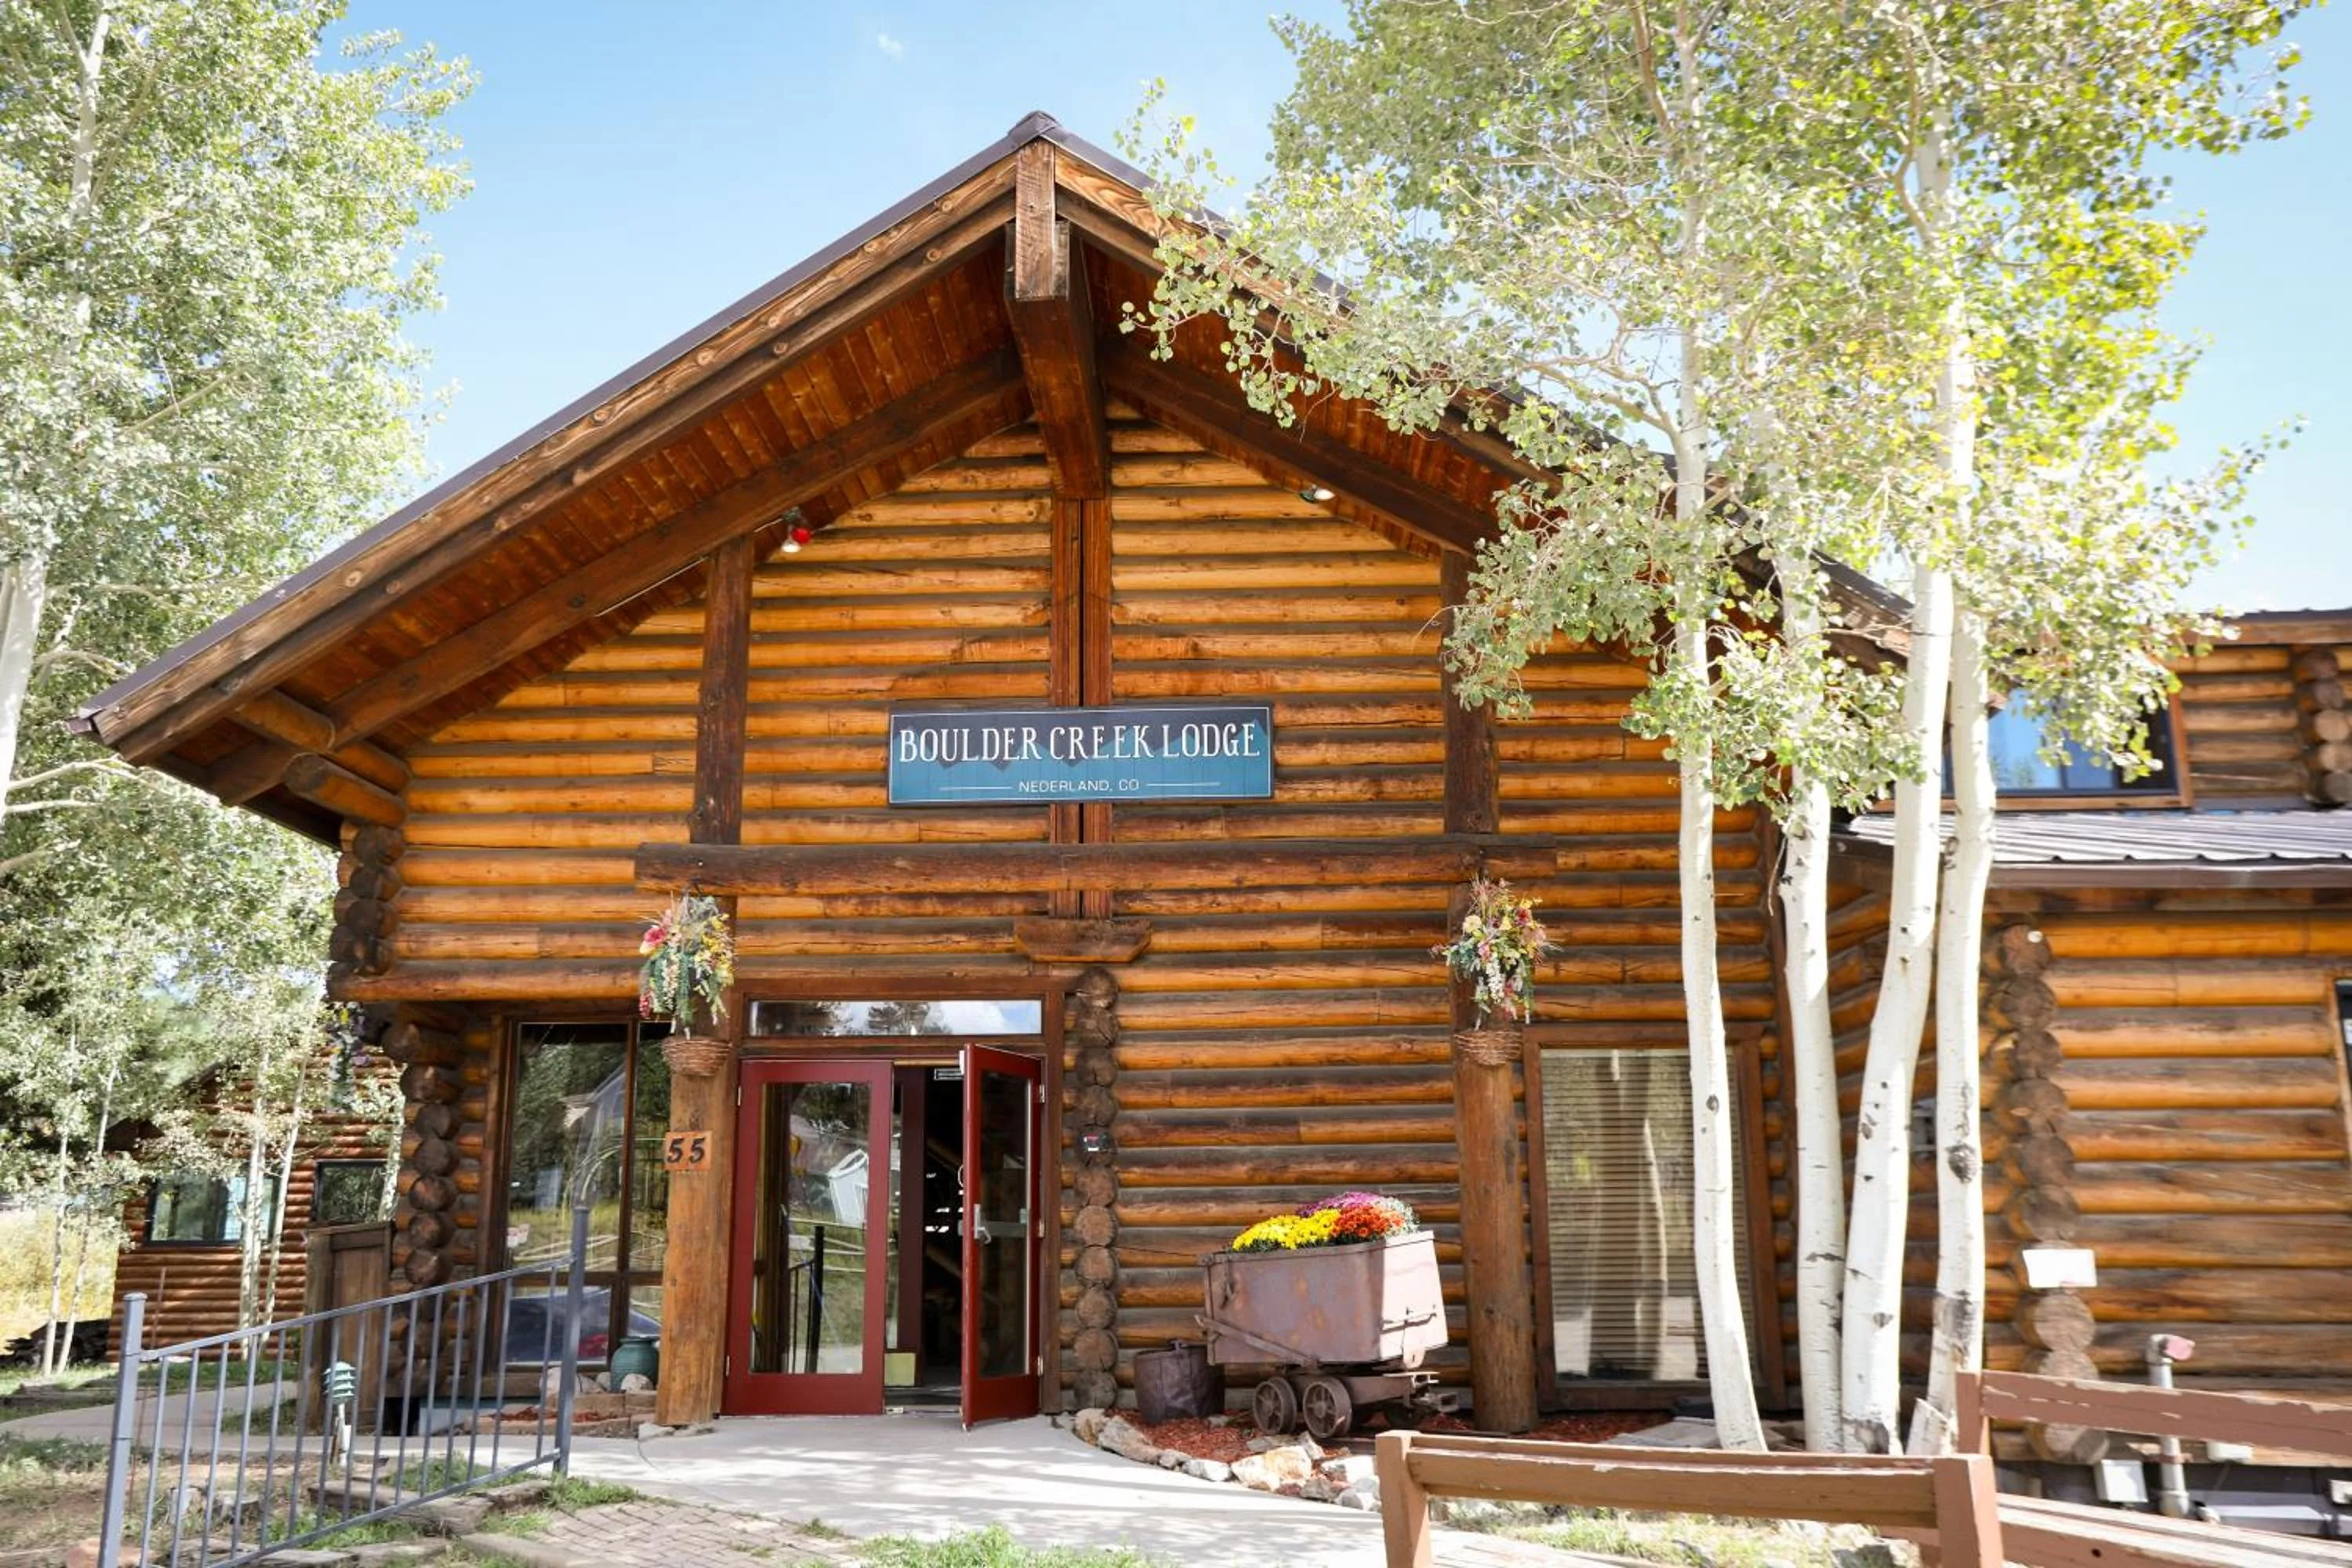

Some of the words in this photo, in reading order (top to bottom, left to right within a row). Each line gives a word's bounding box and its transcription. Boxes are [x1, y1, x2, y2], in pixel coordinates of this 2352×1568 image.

[899, 727, 1042, 763] BOULDER
[1049, 724, 1154, 760] CREEK
[1162, 722, 1261, 758] LODGE
[1018, 780, 1113, 793] NEDERLAND,
[1119, 779, 1140, 792] CO
[666, 1138, 706, 1163] 55
